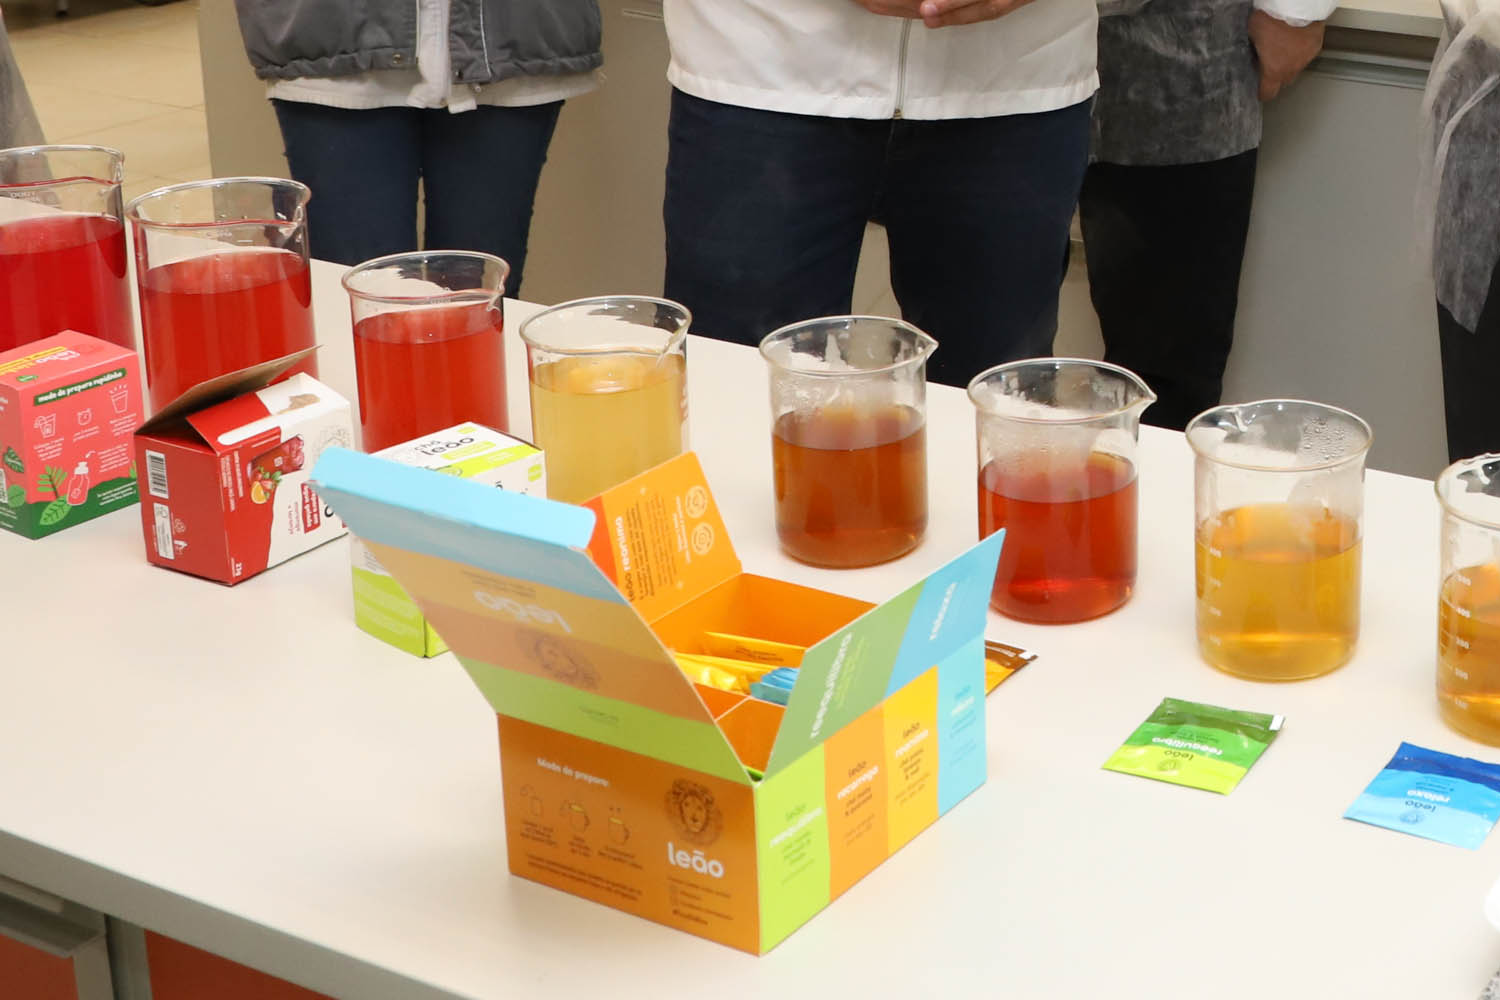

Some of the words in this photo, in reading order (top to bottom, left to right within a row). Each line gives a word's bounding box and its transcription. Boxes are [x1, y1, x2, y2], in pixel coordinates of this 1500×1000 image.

[421, 437, 475, 456] leão
[472, 589, 573, 634] leão
[667, 841, 725, 878] leão
